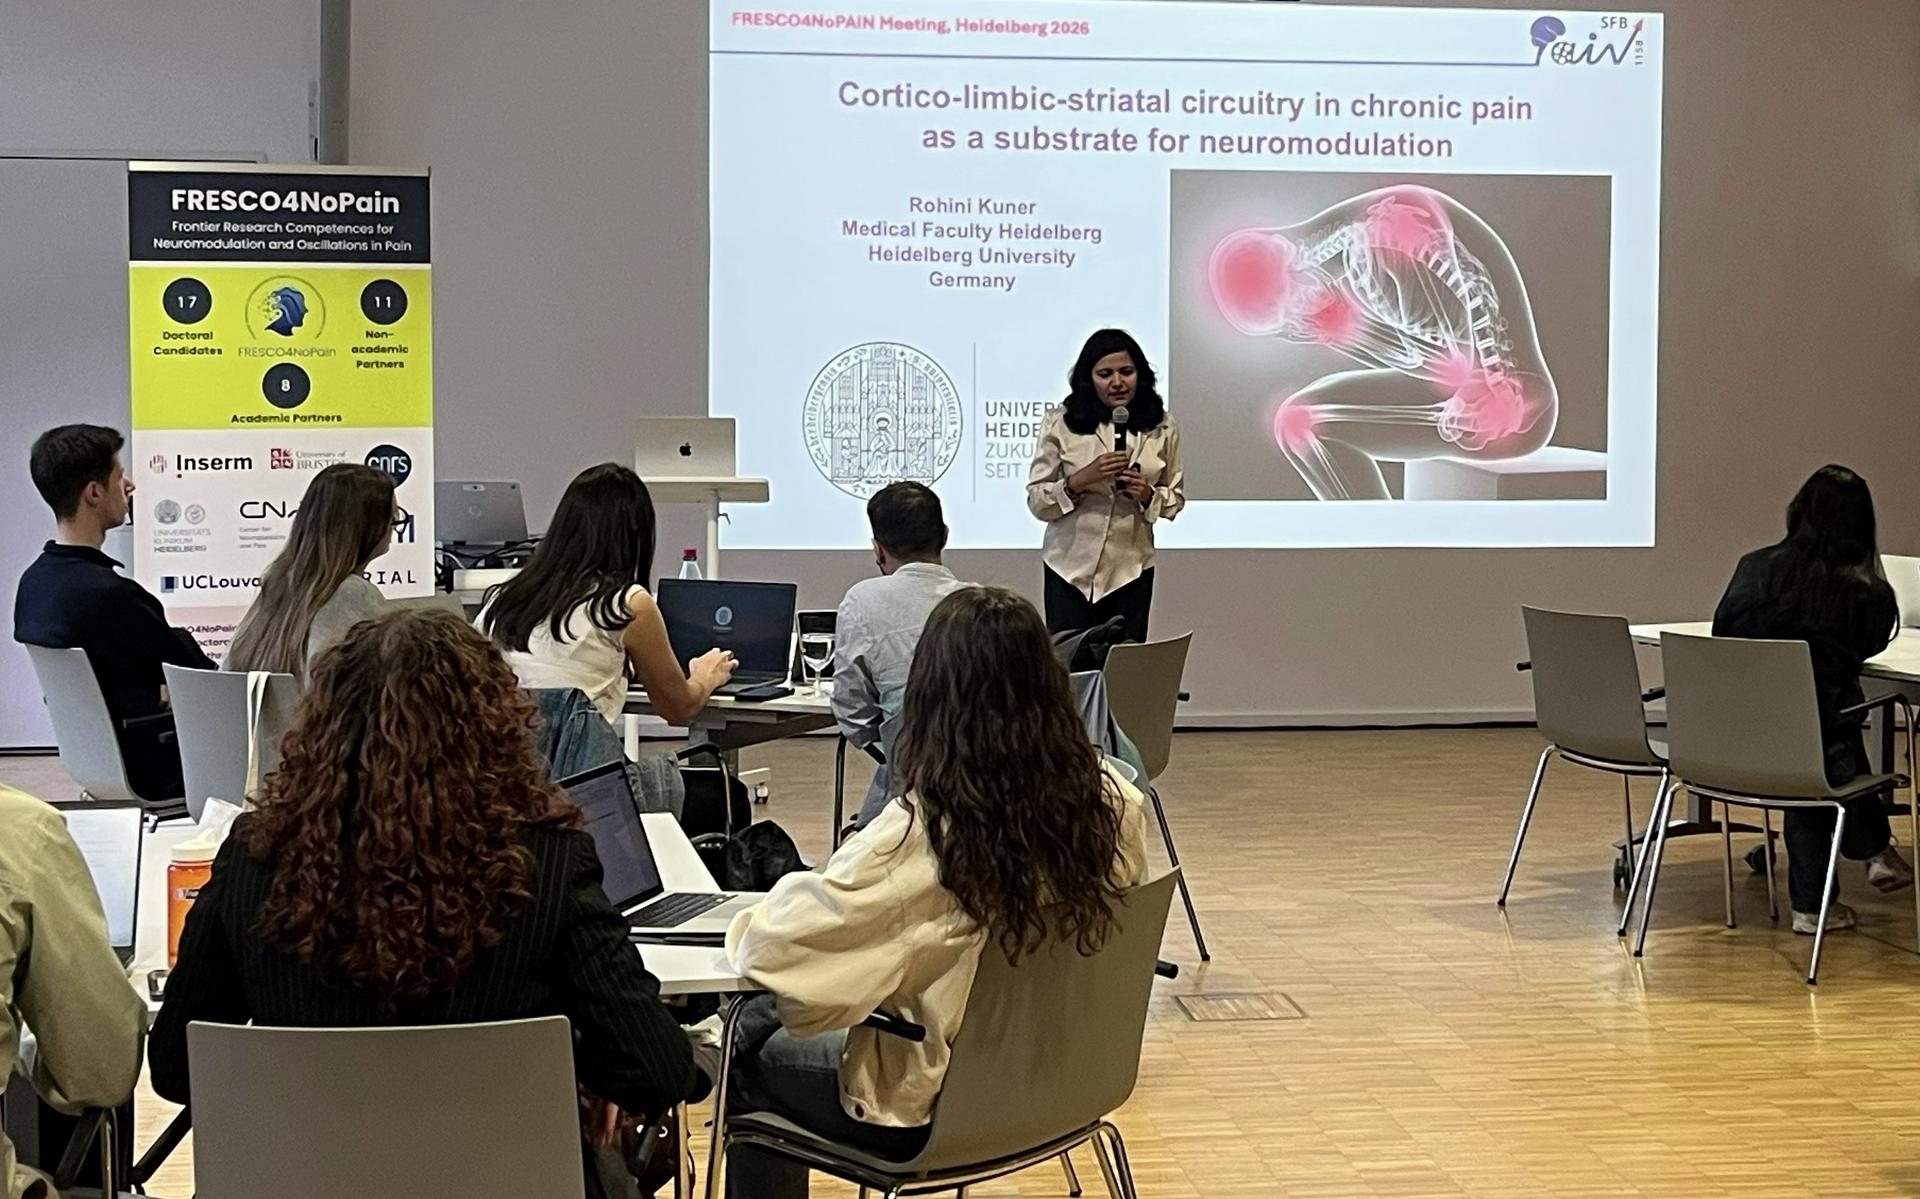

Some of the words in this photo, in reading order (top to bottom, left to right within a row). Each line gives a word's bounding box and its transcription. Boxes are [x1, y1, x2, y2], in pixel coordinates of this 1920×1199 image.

[732, 12, 874, 30] FRESCO4NoPAIN
[880, 16, 950, 34] Meeting,
[956, 18, 1048, 36] Heidelberg
[1050, 20, 1090, 36] 2026
[1600, 16, 1628, 30] SFB
[838, 81, 1170, 114] Cortico-limbic-striatal
[1182, 90, 1304, 122] circuitry
[1316, 92, 1340, 116] in
[1351, 94, 1462, 120] chronic
[1472, 96, 1532, 125] pain
[922, 129, 956, 148] as
[967, 130, 984, 150] a
[994, 126, 1138, 152] substrate
[1148, 128, 1190, 153] for
[1200, 131, 1452, 158] neuromodulation
[172, 189, 400, 214] FRESCO4NoPain
[910, 197, 972, 214] Rohini
[978, 198, 1036, 216] Kuner
[172, 221, 220, 232] Frontier
[223, 222, 282, 233] Research
[286, 222, 374, 236] Competences
[376, 224, 394, 234] for
[842, 220, 916, 238] Medical
[922, 222, 992, 242] Faculty
[999, 224, 1102, 244] Heidelberg
[154, 238, 265, 250] Neuromodulation
[269, 240, 294, 250] and
[297, 240, 368, 252] Oscillations
[371, 240, 382, 251] in
[385, 241, 412, 252] Pain
[868, 246, 972, 267] Heidelberg
[979, 248, 1076, 270] University
[928, 272, 1016, 292] Germany
[178, 296, 197, 308] 17
[374, 296, 392, 308] 11
[163, 331, 213, 340] Doctoral
[366, 330, 394, 340] Non-
[154, 346, 222, 356] Candidates
[238, 347, 336, 357] FRESCO4NoPain
[352, 345, 408, 354] academic
[356, 360, 404, 370] Partners
[280, 379, 290, 392] 8
[232, 414, 290, 424] Academic
[293, 414, 342, 424] Partners
[176, 454, 252, 478] Inserm
[985, 462, 1022, 478] SEIT
